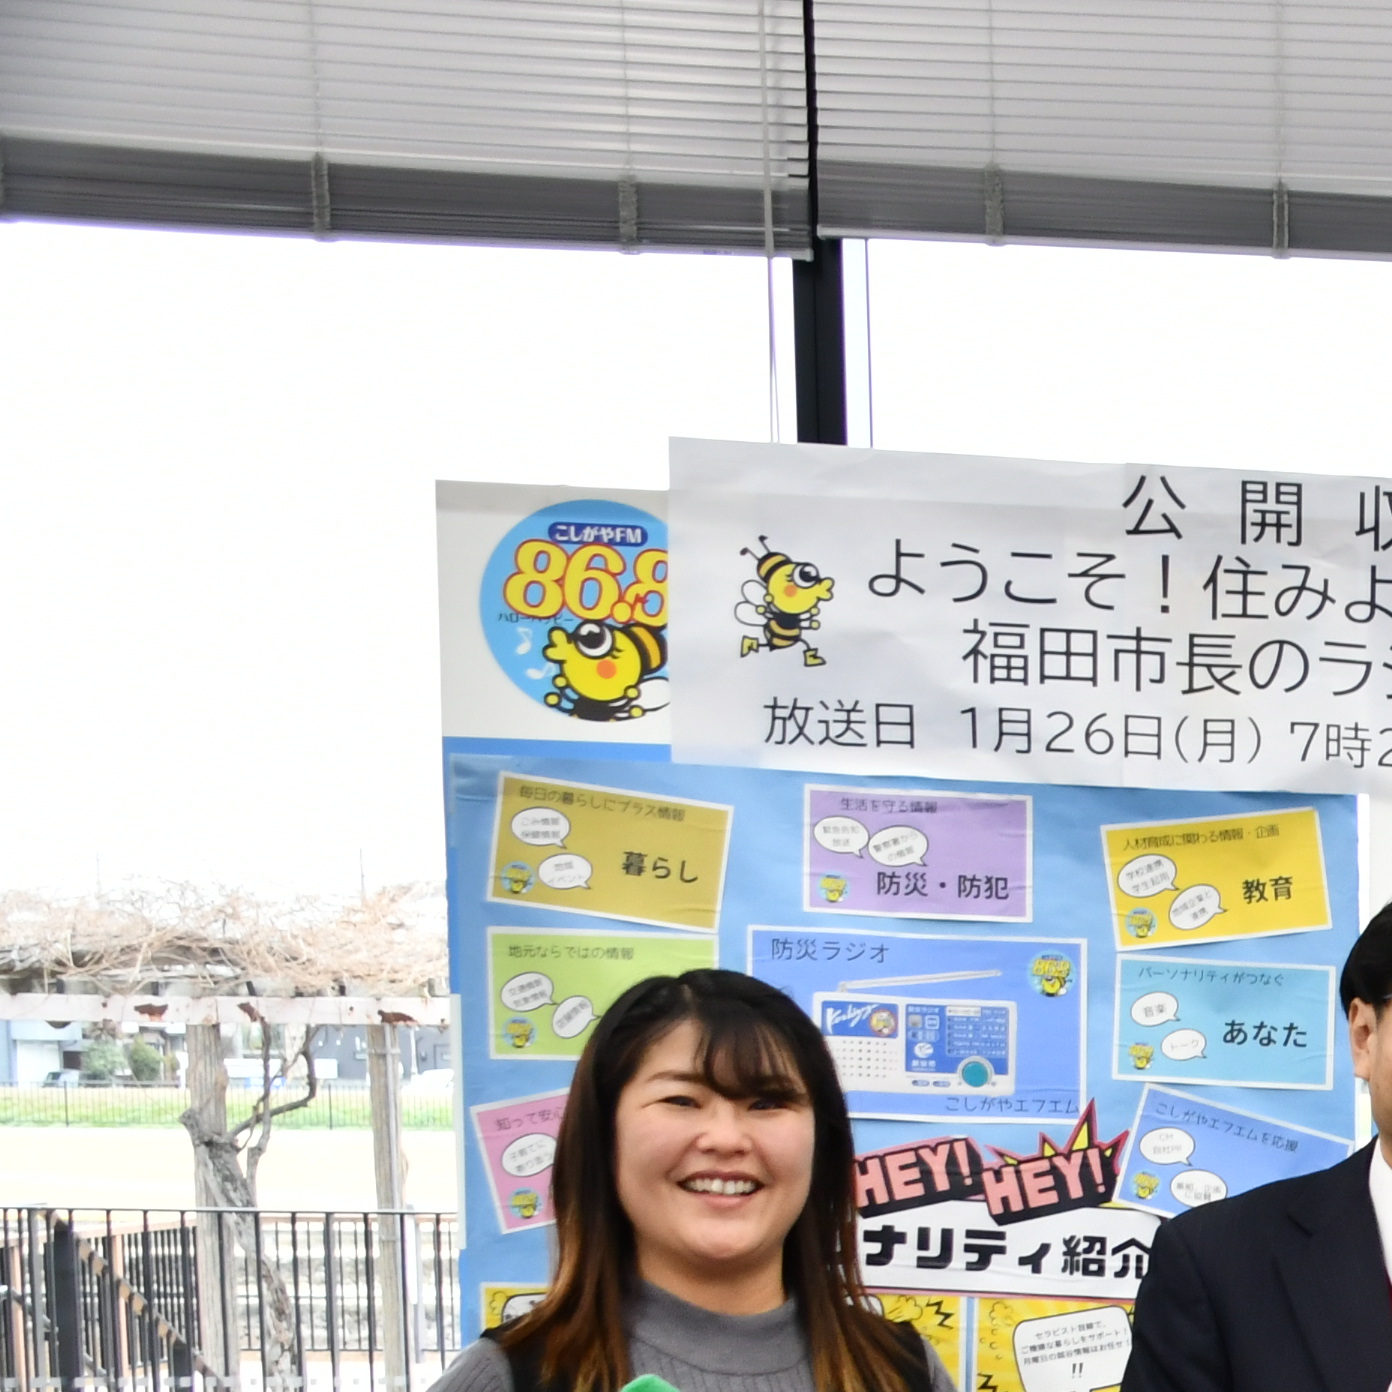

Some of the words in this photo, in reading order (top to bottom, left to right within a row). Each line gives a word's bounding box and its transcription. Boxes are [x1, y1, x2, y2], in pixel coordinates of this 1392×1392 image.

[554, 524, 642, 544] こしがやFM
[503, 538, 668, 628] 86.8
[621, 850, 699, 884] 暮らし
[876, 870, 1010, 900] 防災・防犯
[1242, 875, 1294, 905] 教育
[770, 938, 890, 964] 防災ラジオ
[1222, 1019, 1308, 1049] あなた
[944, 1096, 1080, 1114] こしがやエフエム
[855, 1139, 973, 1209] HEY!
[982, 1147, 1106, 1216] HEY!
